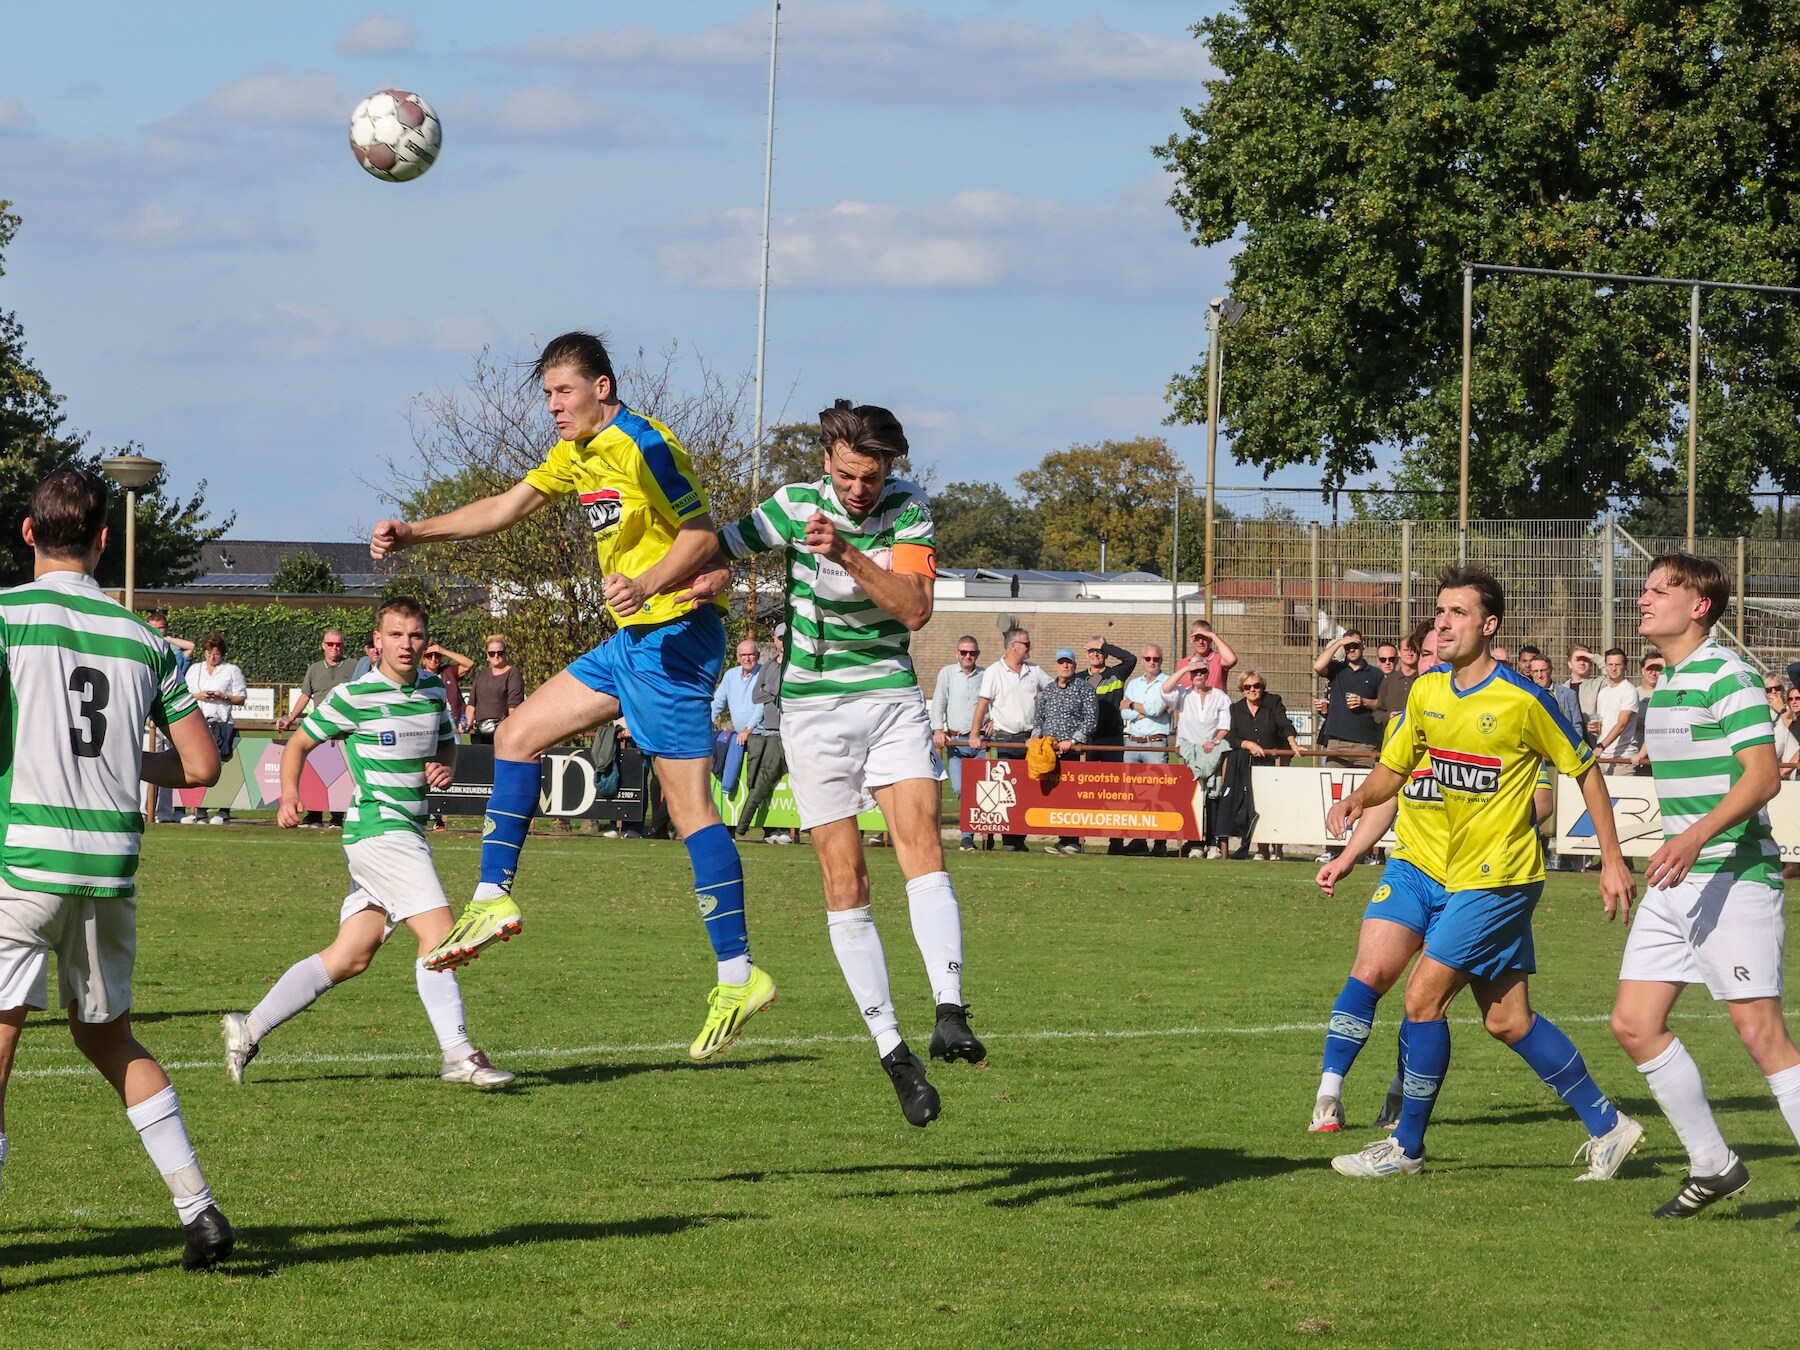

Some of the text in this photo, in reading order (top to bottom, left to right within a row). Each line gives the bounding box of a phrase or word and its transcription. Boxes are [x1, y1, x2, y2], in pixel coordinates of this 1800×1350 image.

[822, 567, 850, 577] BORREN
[68, 666, 110, 758] 3
[244, 703, 270, 712] Kwinten
[1423, 710, 1446, 720] PATRICK
[264, 763, 280, 772] mu
[1078, 772, 1120, 785] grootste
[1123, 772, 1178, 785] leverancier
[1077, 788, 1134, 800] van vloeren
[1049, 811, 1159, 828] ESCOVLOEREN.NL
